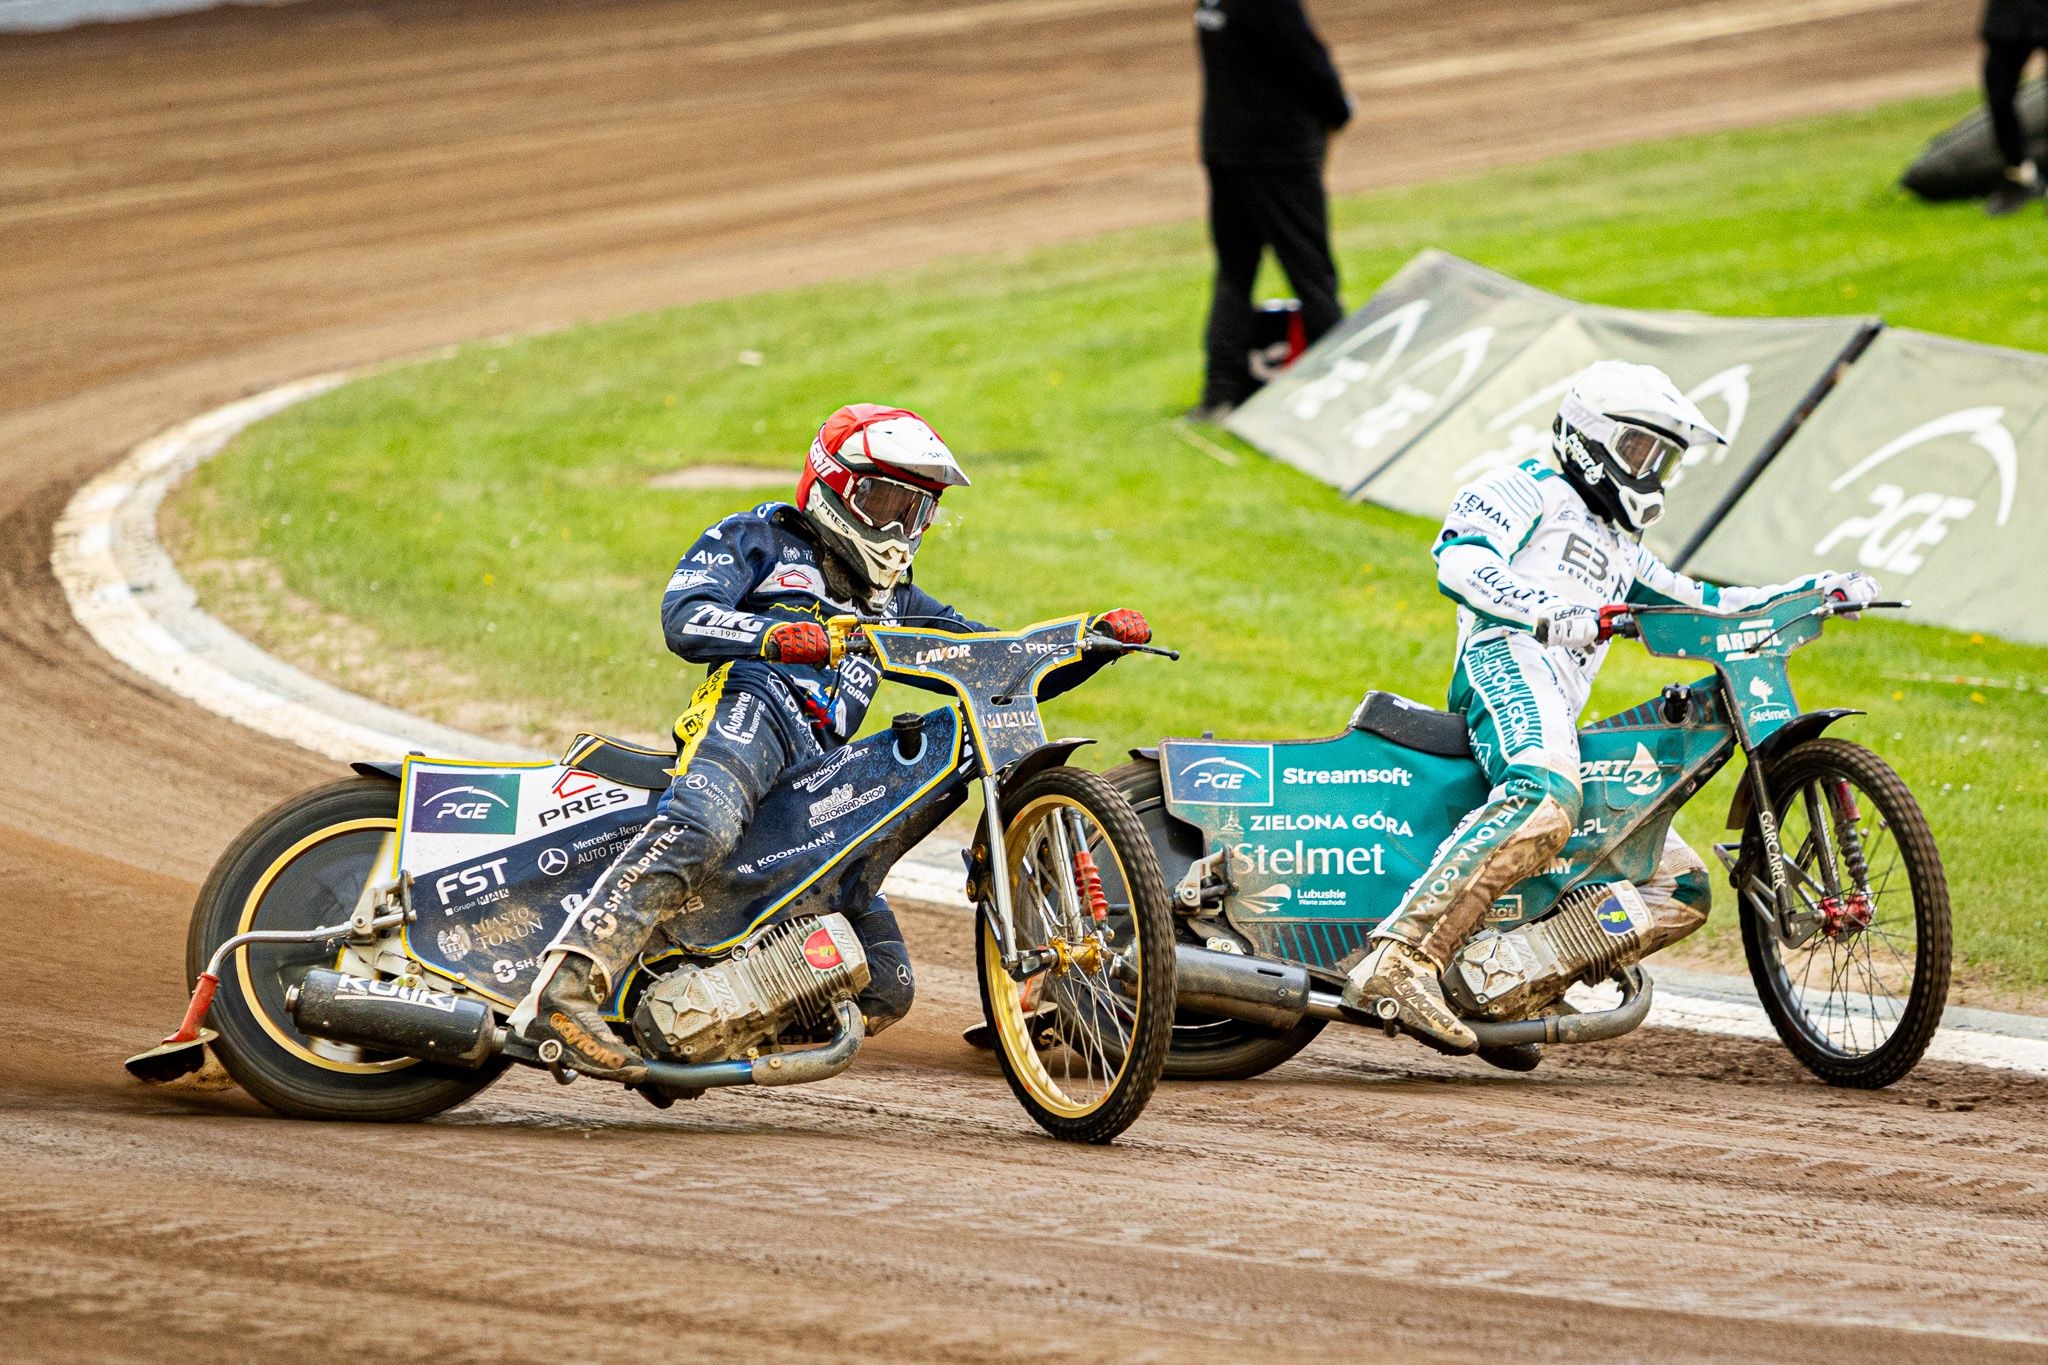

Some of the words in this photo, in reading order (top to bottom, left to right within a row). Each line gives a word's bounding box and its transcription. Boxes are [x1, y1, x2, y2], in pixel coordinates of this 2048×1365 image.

[819, 502, 849, 534] PRES
[1814, 484, 1976, 574] PGE
[691, 550, 734, 565] AVO
[915, 644, 971, 665] LAVOR
[1025, 643, 1071, 655] PRES
[1749, 709, 1792, 726] Stelmet
[793, 748, 868, 790] BRUNKHORST
[1194, 772, 1245, 789] PGE
[1282, 767, 1412, 787] Streamsoft
[1627, 769, 1660, 787] 24
[437, 802, 491, 819] PGE
[539, 789, 629, 827] PRES
[1250, 814, 1348, 831] ZIELONA
[1352, 810, 1413, 837] GÓRA
[1453, 796, 1528, 863] ZIELONA
[573, 824, 643, 851] Mercedes-Benz
[757, 830, 836, 867] KOOPMANN
[1761, 810, 1787, 890] GARCAREK
[578, 846, 607, 864] AUTO
[1233, 840, 1386, 875] Stelmet
[436, 857, 508, 905] FST
[1297, 889, 1346, 899] Lubuskie
[454, 902, 475, 913] Grupa
[472, 907, 529, 935] MIASTO
